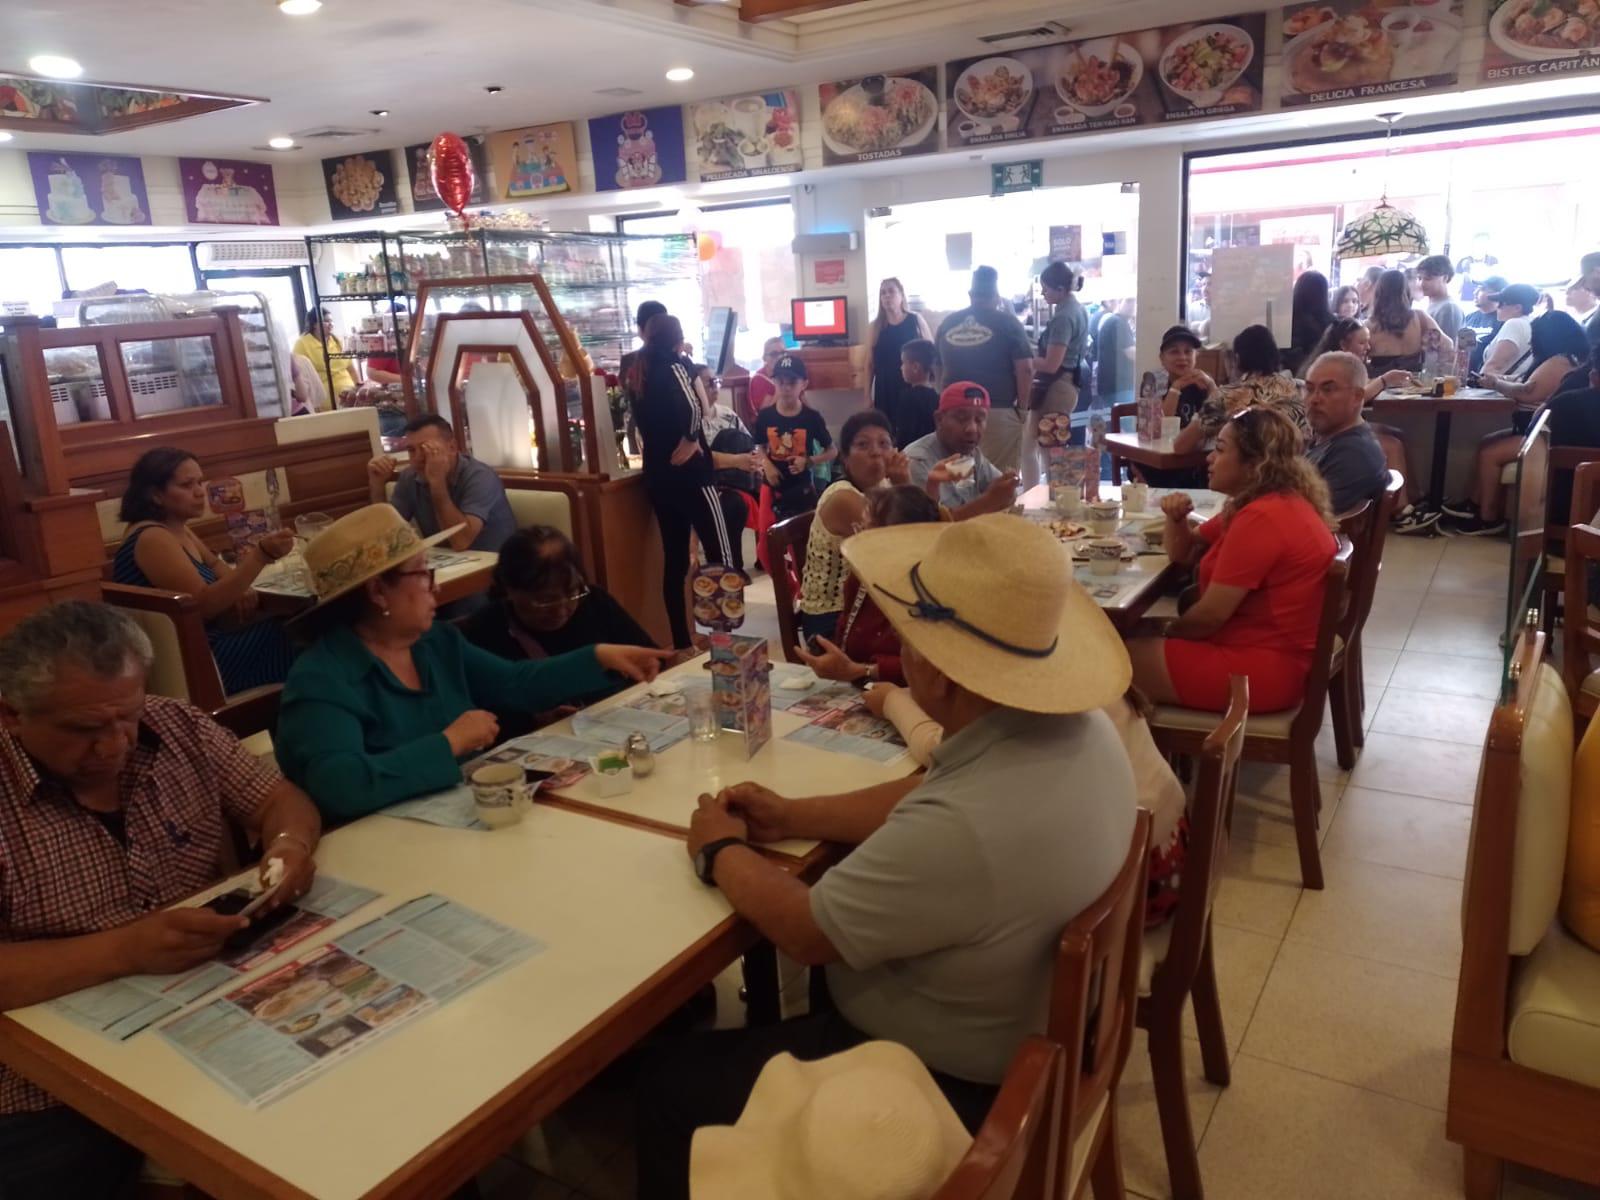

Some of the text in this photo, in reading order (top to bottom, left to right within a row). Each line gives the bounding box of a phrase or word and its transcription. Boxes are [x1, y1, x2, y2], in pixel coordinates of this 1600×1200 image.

[1487, 64, 1537, 79] BISTEC
[1309, 79, 1426, 102] DELICIA FRANCESA
[856, 149, 903, 161] TOSTADAS
